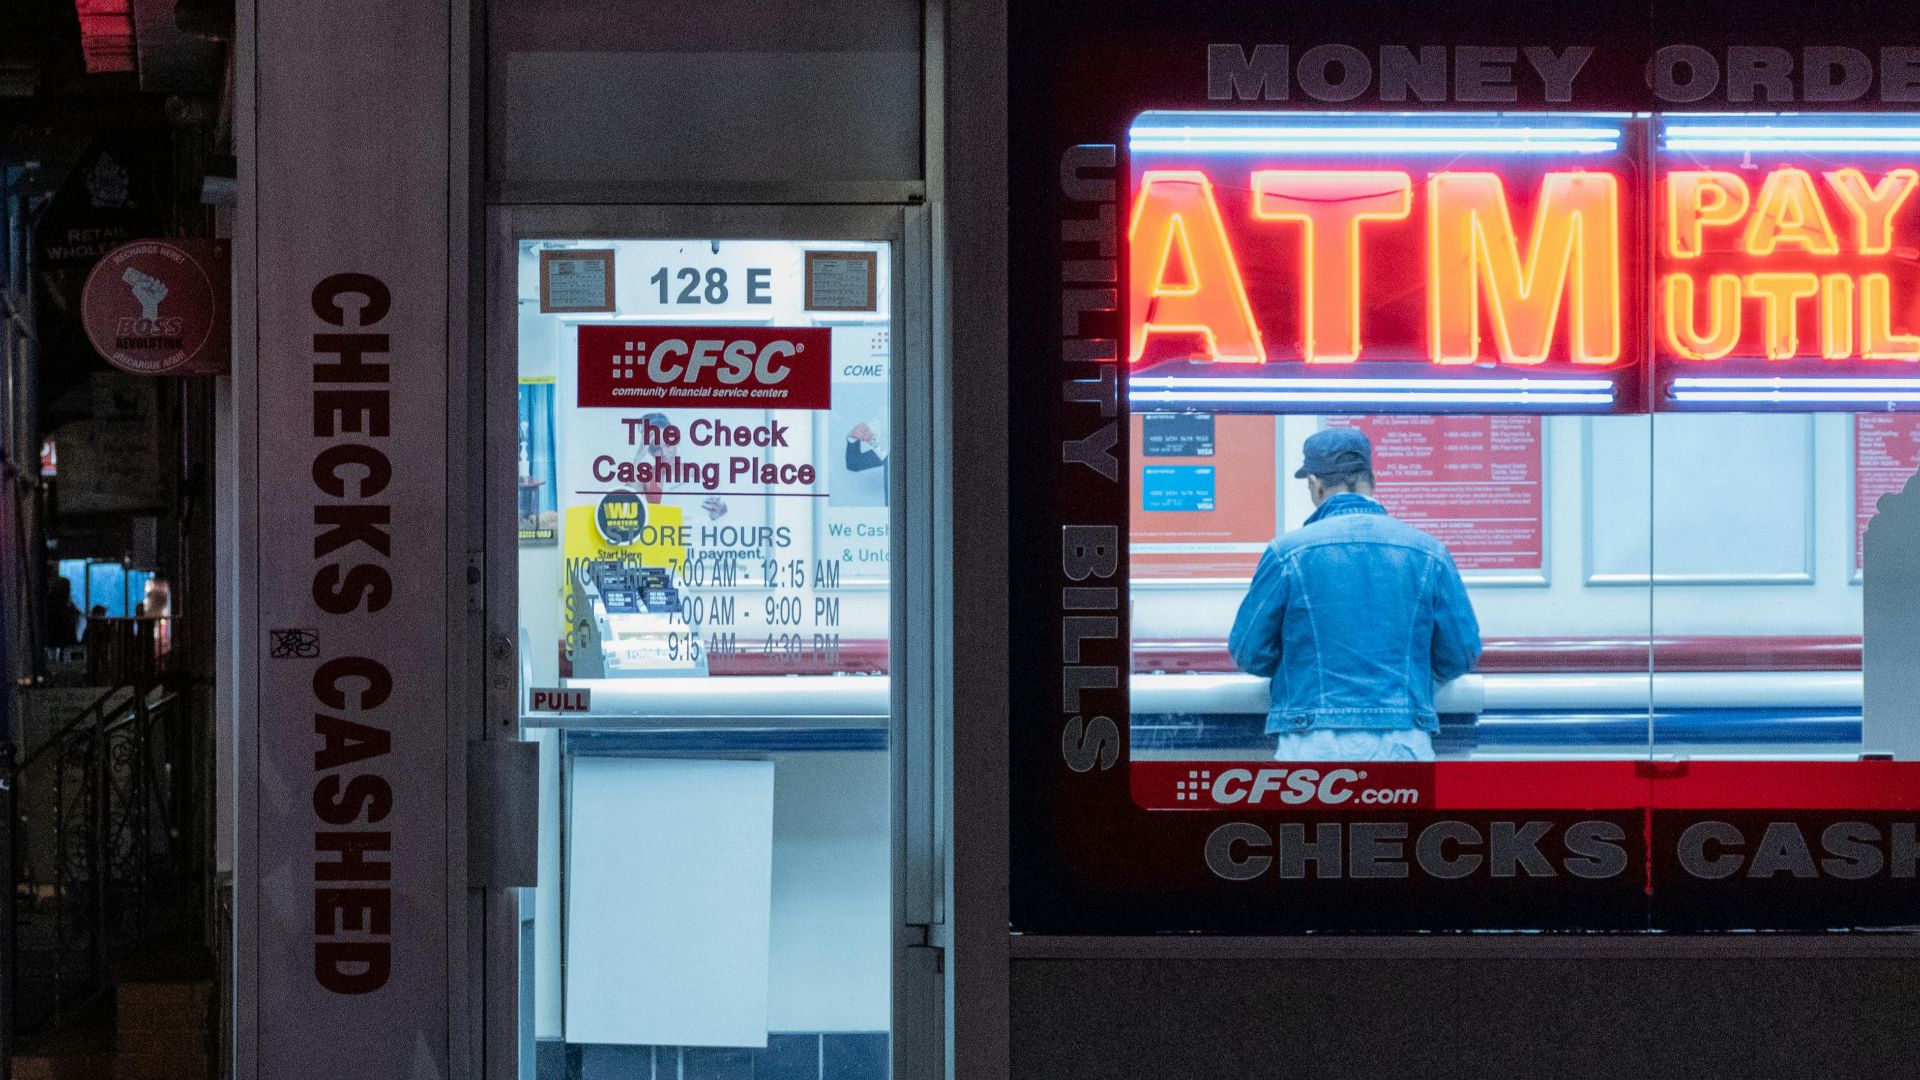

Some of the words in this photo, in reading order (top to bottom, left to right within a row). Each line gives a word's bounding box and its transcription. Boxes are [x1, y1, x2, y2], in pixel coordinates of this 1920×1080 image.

[1207, 44, 1595, 102] MONEY
[1667, 167, 1919, 258] PAY
[1129, 170, 1622, 365] ATM
[650, 267, 729, 304] 128
[746, 268, 772, 304] E
[116, 316, 184, 336] BOSS
[1060, 143, 1118, 482] UTILITY
[1665, 272, 1920, 361] UTIL
[843, 364, 883, 377] COME
[612, 386, 667, 398] community
[669, 386, 711, 397] financial
[712, 387, 749, 398] service
[750, 387, 788, 398] centers
[311, 272, 392, 615] CHECKS
[621, 418, 681, 446] The
[689, 418, 789, 447] Check
[592, 455, 720, 490] Cashing
[729, 456, 816, 485] Place
[606, 525, 692, 547] STORE
[701, 526, 792, 547] HOURS
[829, 523, 852, 537] We
[842, 548, 853, 561] &
[668, 558, 704, 588] 7:00
[711, 559, 736, 588] AM
[761, 559, 805, 588] 12:15
[814, 559, 840, 588] AM
[709, 596, 735, 625] AM
[765, 596, 801, 625] 9:00
[815, 597, 839, 626] PM
[668, 632, 699, 661] 9:15
[709, 632, 736, 663] AM
[813, 633, 839, 664] PM
[1061, 524, 1120, 772] BILLS
[533, 692, 588, 711] PULL
[312, 656, 393, 995] CASHED
[1204, 821, 1628, 881] CHECKS
